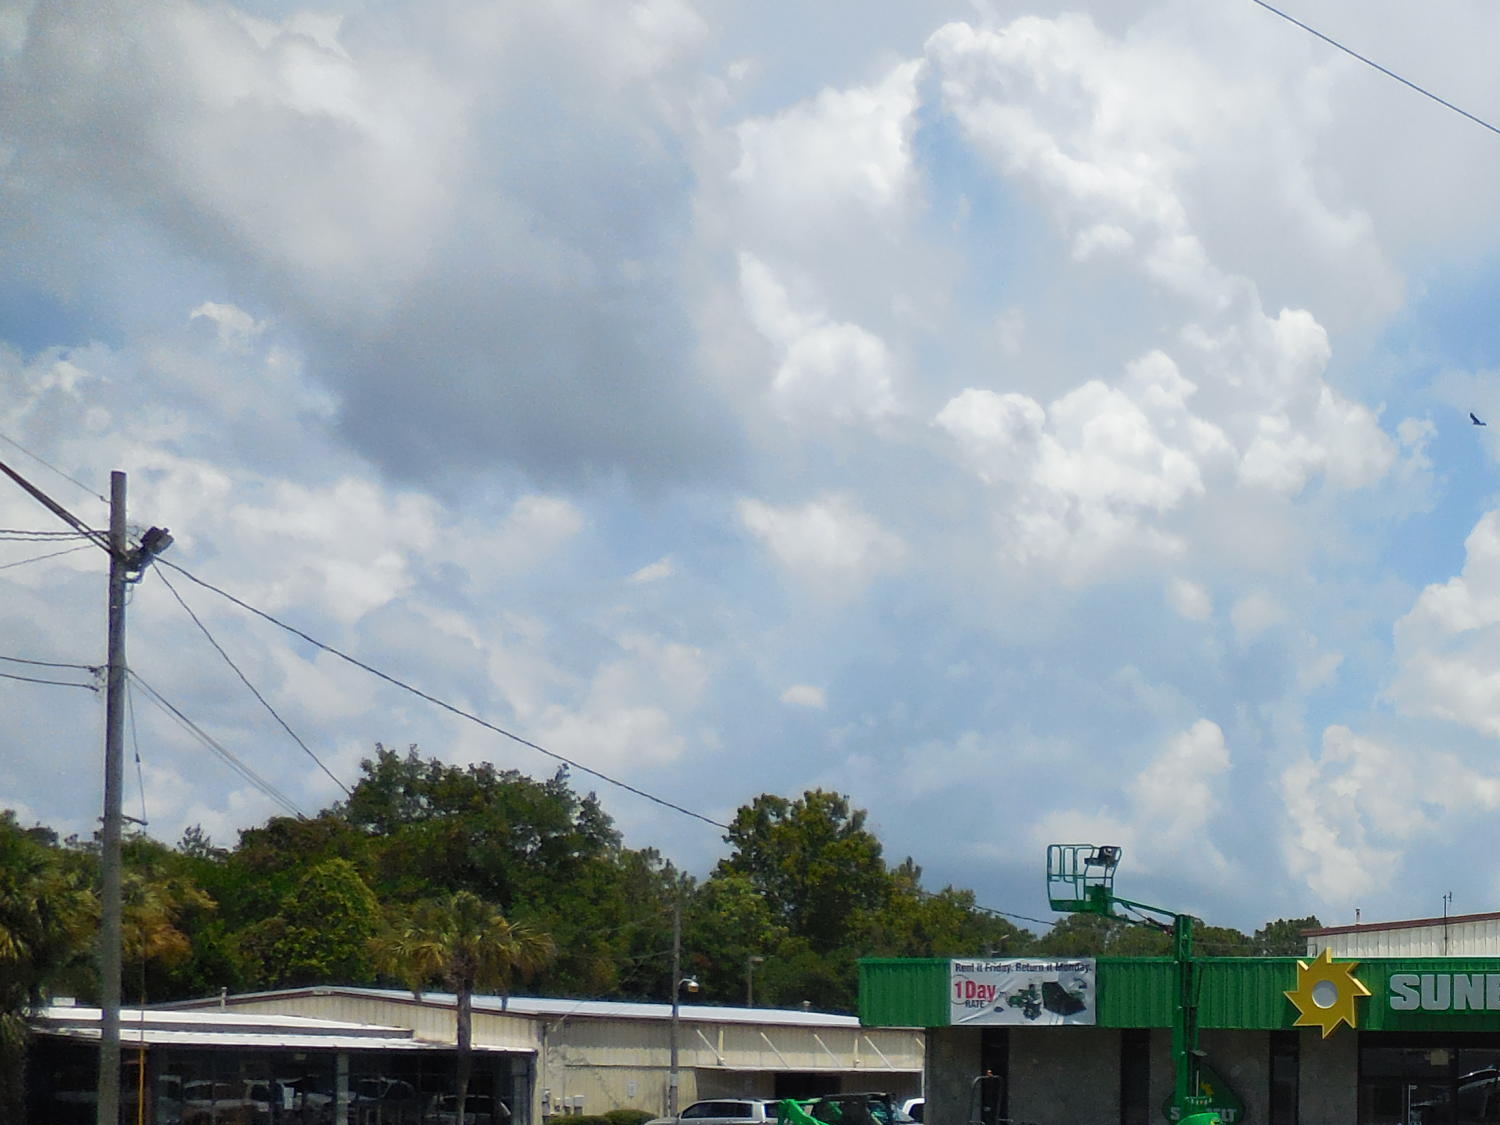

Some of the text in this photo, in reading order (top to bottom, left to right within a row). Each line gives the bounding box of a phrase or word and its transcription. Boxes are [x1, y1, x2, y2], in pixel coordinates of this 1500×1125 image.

[955, 963, 975, 972] Rent
[1016, 962, 1044, 972] Return
[954, 980, 996, 1002] 1 Day
[965, 1000, 984, 1009] RATE
